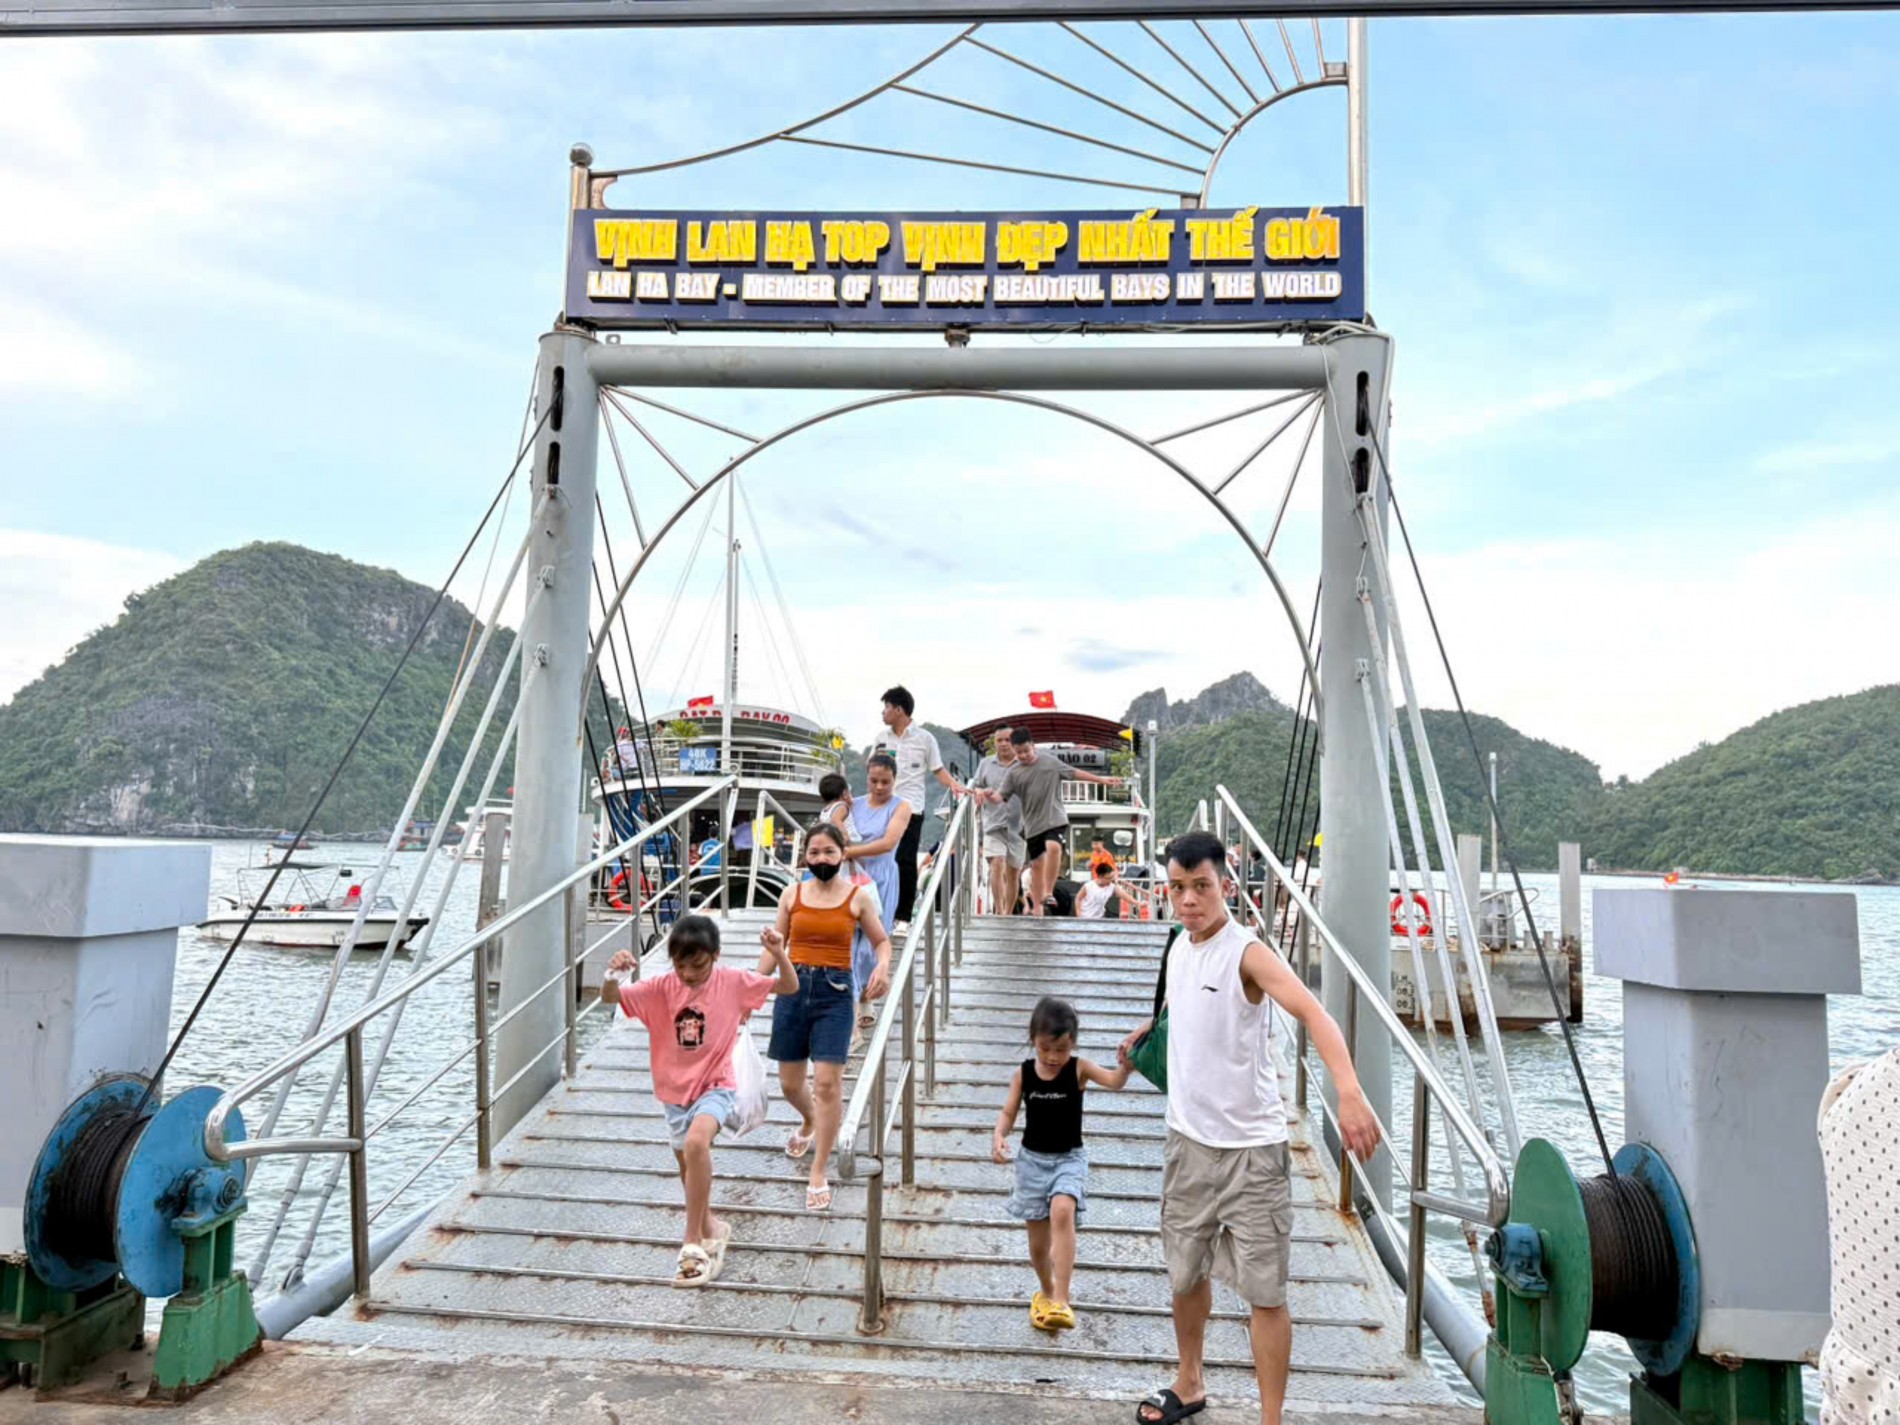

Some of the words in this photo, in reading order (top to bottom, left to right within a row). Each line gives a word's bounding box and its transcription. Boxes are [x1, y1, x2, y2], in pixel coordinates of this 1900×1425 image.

[594, 219, 678, 269] VỊNH
[687, 220, 756, 263] LAN
[765, 221, 816, 271] HẠ
[821, 221, 890, 262] TOP
[901, 221, 986, 271] VỊNH
[996, 221, 1068, 271] ĐẸP
[1078, 208, 1174, 262] NHẤT
[1186, 206, 1259, 260] THẾ
[1265, 207, 1340, 260] GIỚI
[587, 271, 631, 298] LAN
[636, 272, 669, 299] HA
[675, 272, 720, 299] BAY
[742, 273, 837, 301] MEMBER
[841, 274, 871, 301] OF
[878, 274, 919, 302] THE
[926, 275, 988, 302] MOST
[994, 275, 1104, 300] BEAUTIFUL
[1111, 274, 1170, 299] BAYS
[1177, 273, 1204, 298] IN
[1212, 273, 1255, 298] THE
[1262, 272, 1342, 298] WORLD
